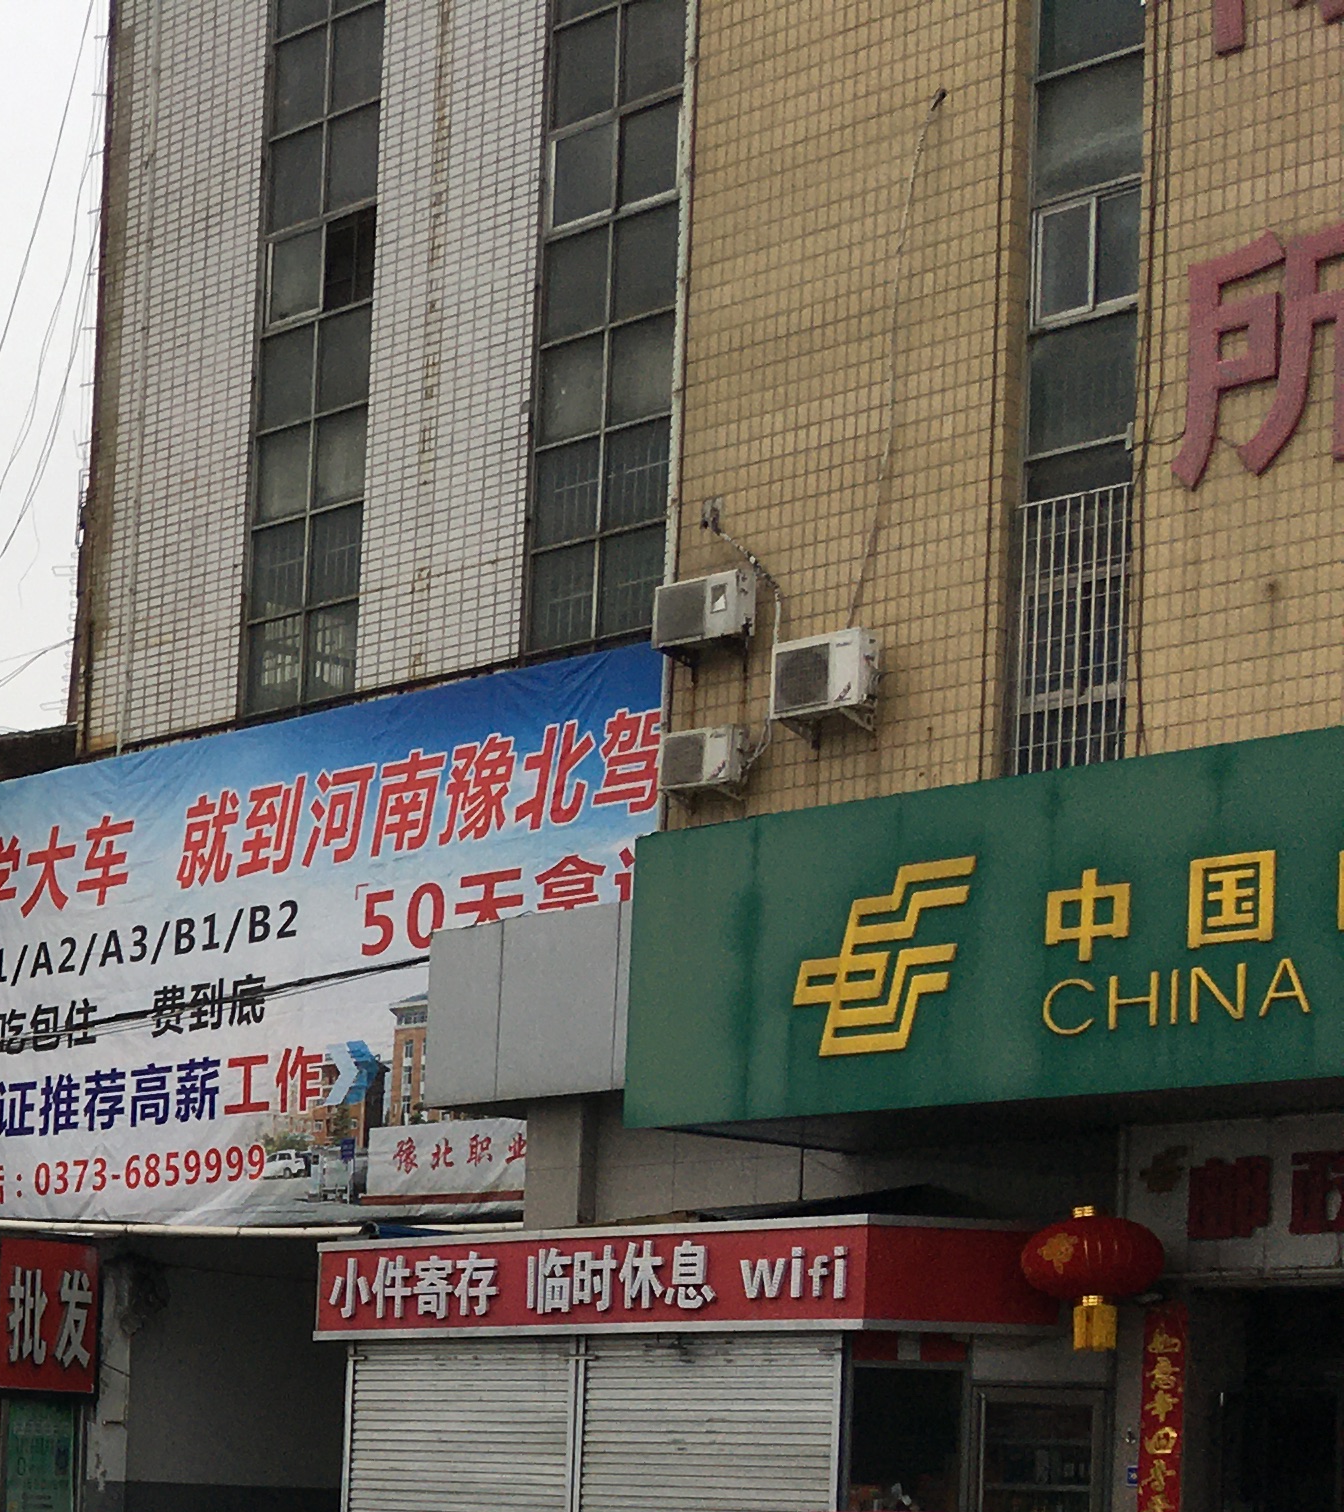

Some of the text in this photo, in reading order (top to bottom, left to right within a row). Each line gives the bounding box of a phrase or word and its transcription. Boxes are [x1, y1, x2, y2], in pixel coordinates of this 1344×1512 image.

[175, 707, 662, 890] 就到河南豫北驾
[361, 850, 635, 957] 50天拿
[1044, 849, 1344, 962] 中国
[1042, 957, 1311, 1036] CHINA
[7, 1266, 94, 1369] 批发
[329, 1240, 848, 1319] 小件寄存 临时休息 wifi
